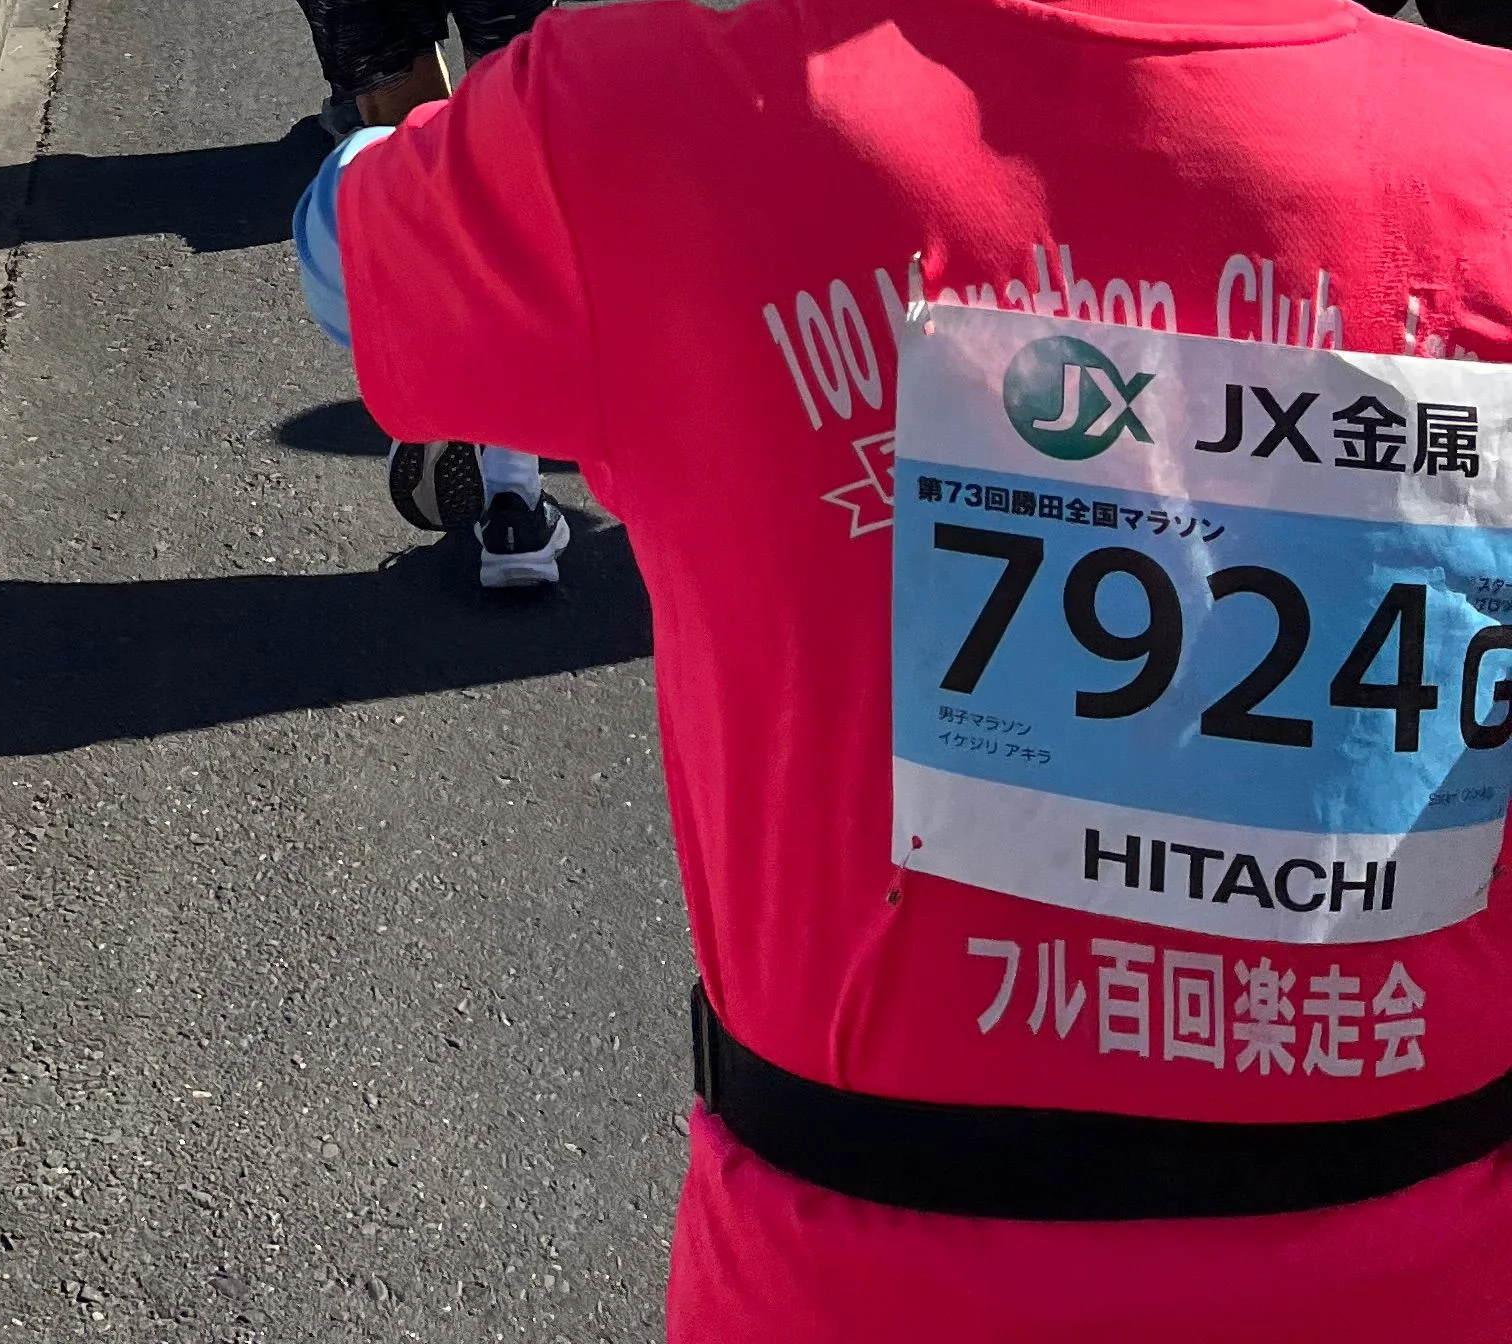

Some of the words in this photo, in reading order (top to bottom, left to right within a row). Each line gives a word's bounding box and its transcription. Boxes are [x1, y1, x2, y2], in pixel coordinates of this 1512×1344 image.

[762, 278, 884, 432] 100
[1194, 383, 1480, 479] JX金属
[918, 475, 1225, 543] 第73回勝田全国マラソン
[938, 705, 1032, 736] 男子マラソン
[1005, 743, 1051, 764] アキラ
[1083, 828, 1397, 914] HITACHI
[966, 936, 1428, 1079] フル百回楽走会
